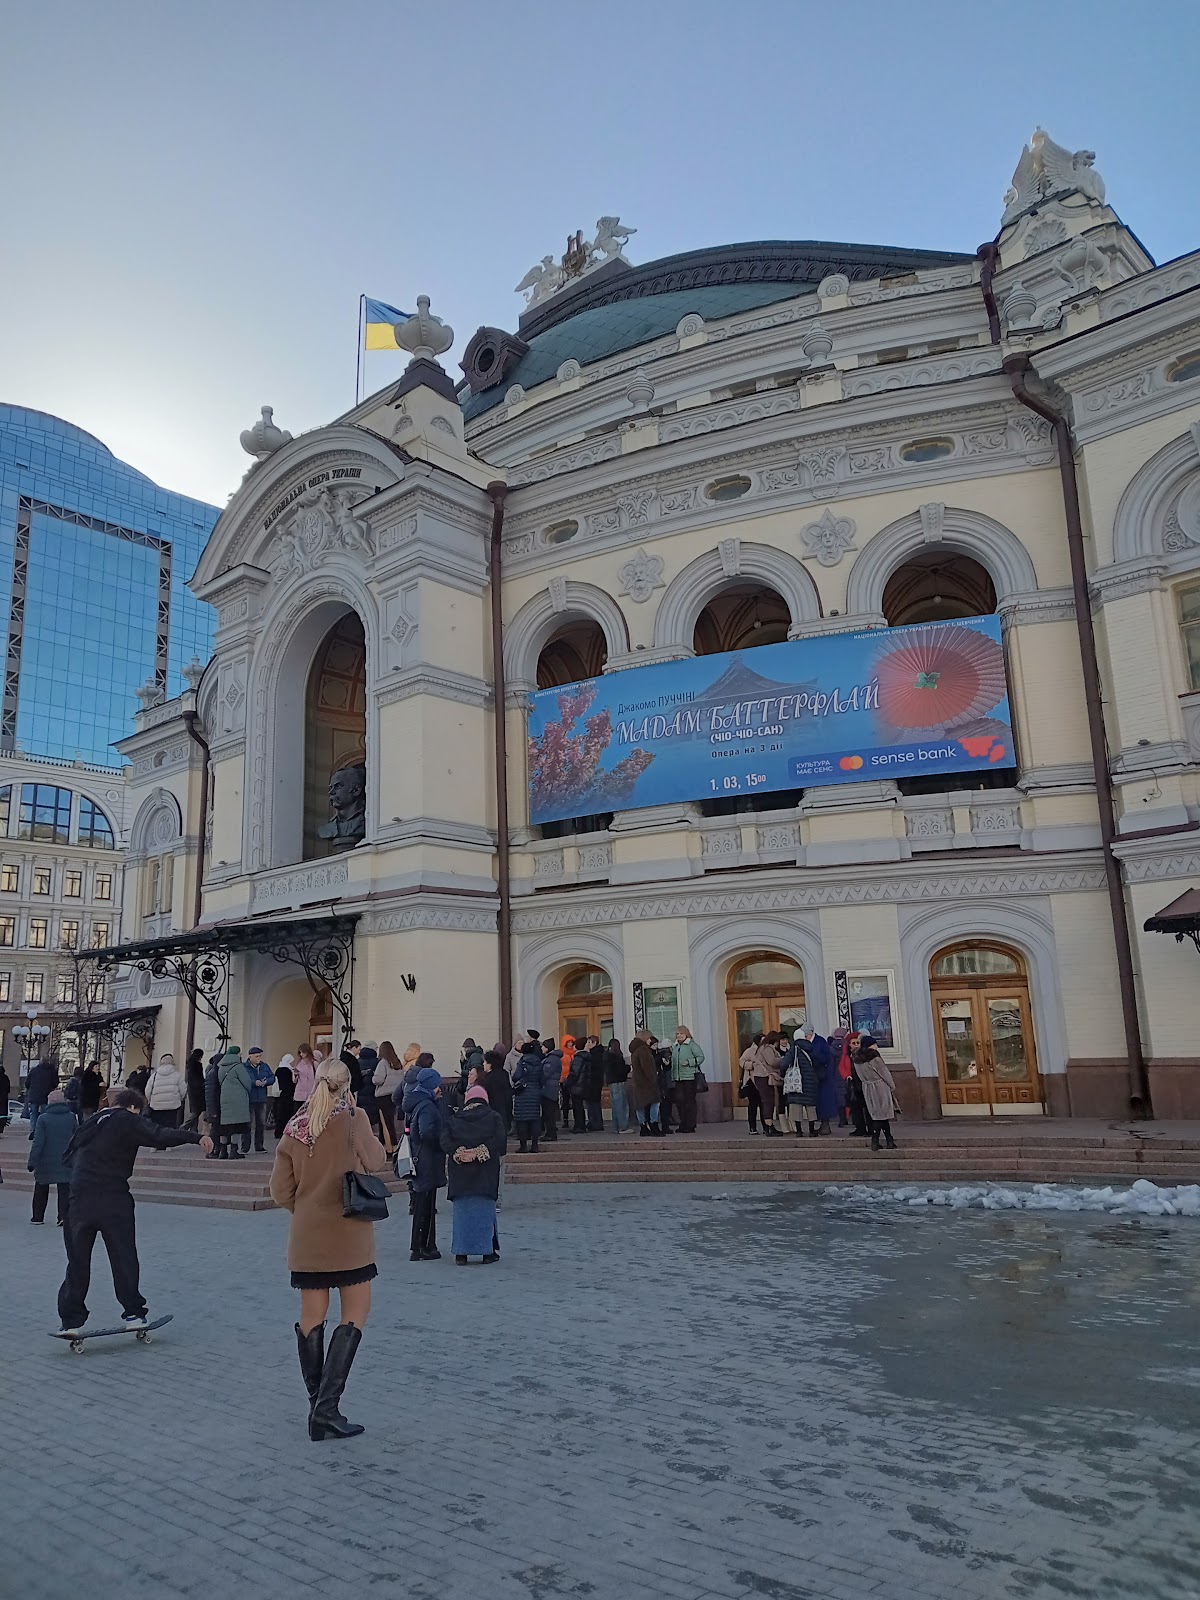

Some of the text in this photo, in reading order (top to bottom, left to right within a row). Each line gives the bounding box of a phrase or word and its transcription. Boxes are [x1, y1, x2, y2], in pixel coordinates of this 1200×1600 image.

[308, 472, 330, 488] ОПЕРА
[332, 468, 362, 479] УКРАЇНИ
[854, 630, 891, 640] НАЦІОНАЛЬНА
[908, 625, 931, 633] УКРАЇНИ
[956, 618, 985, 626] ШЕВЧЕНКА
[616, 676, 880, 744] МАДАМ БАТТЕРФЛАЙ
[618, 691, 695, 716] Джакомо ПУЧЧІНІ
[710, 724, 784, 744] (ЧІО-ЧІО-САН)
[711, 749, 740, 758] Опера
[760, 744, 765, 752] 3
[770, 742, 783, 752] дії
[871, 745, 957, 766] sense bank
[796, 759, 831, 769] КУЛЬТУРА
[796, 765, 834, 775] МАЄ СЕНС
